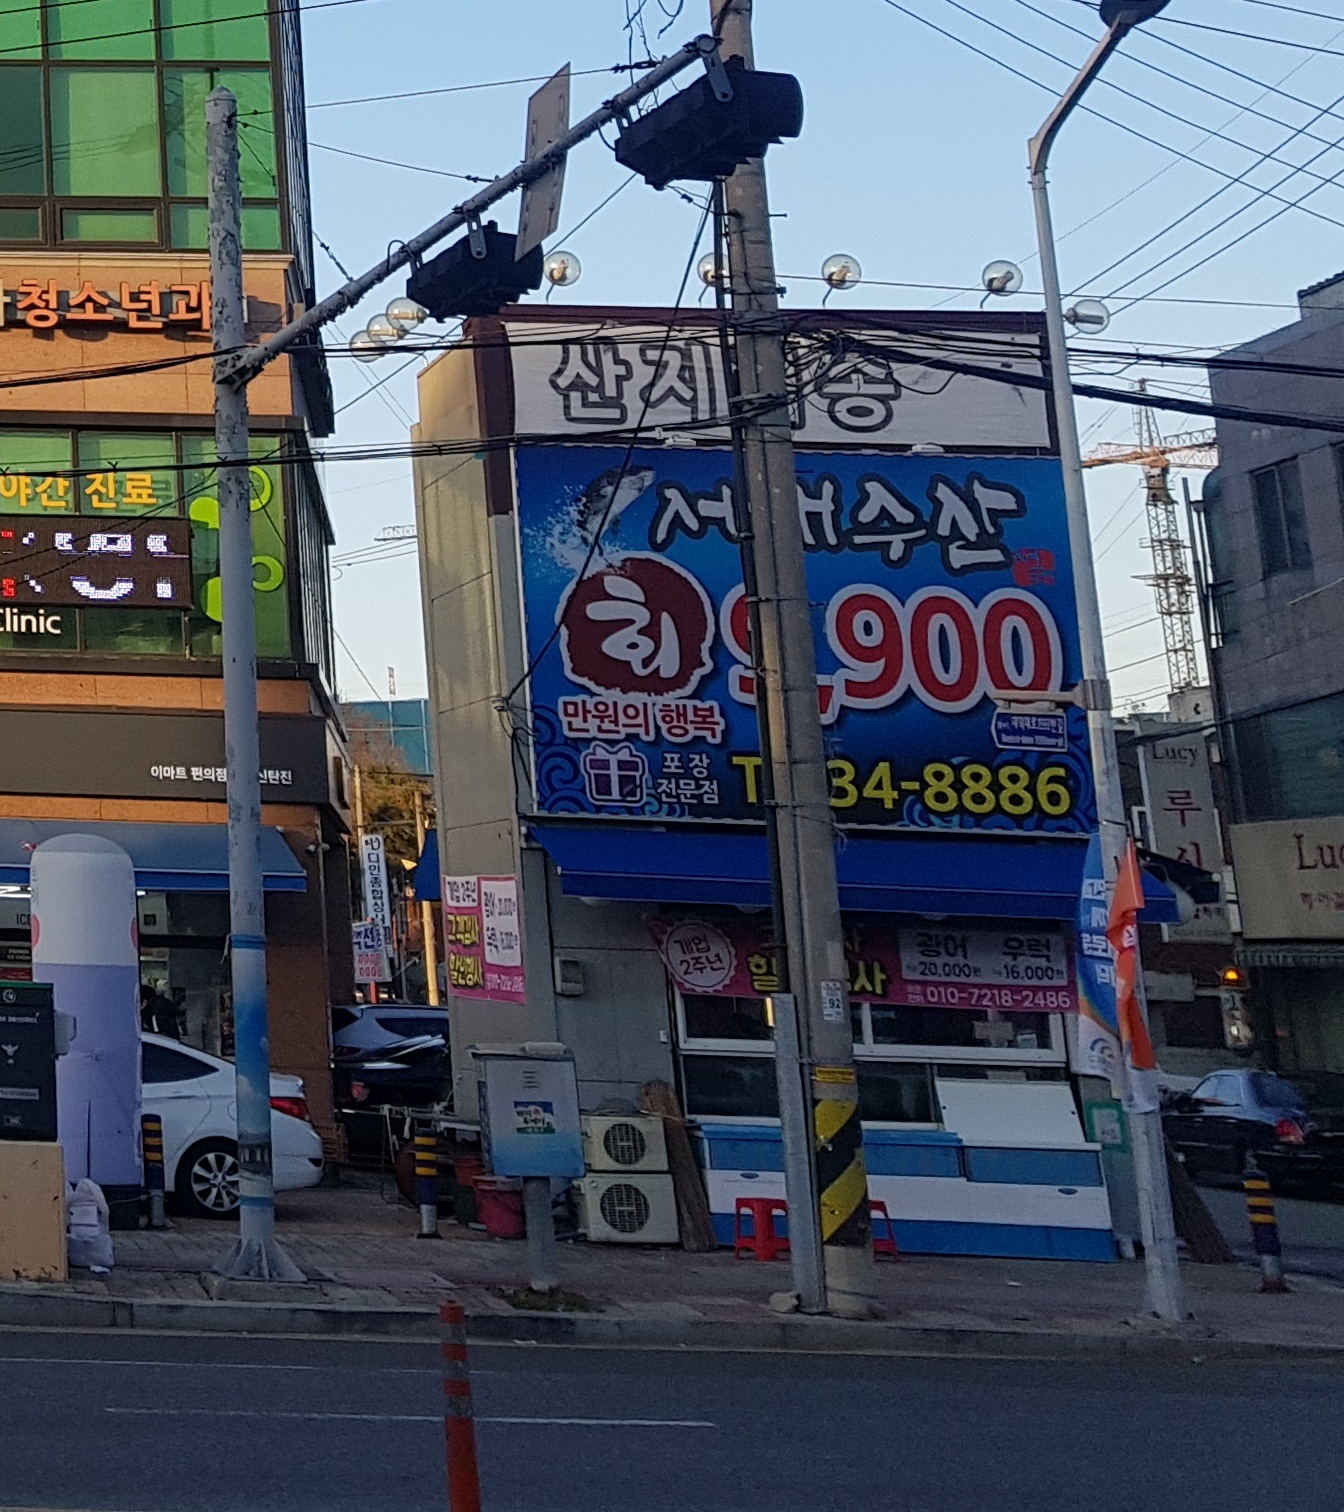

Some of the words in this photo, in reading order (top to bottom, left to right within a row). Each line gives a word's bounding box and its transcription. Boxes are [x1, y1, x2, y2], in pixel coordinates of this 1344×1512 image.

[548, 338, 903, 433] 산지송
[0, 471, 71, 509] 야간
[84, 470, 159, 509] 진료
[584, 574, 682, 678] 회
[558, 697, 652, 742] 만원의
[660, 700, 724, 745] 행복
[660, 752, 711, 777] 포장
[1153, 744, 1199, 768] Lucy
[150, 764, 188, 781] 이마트
[190, 766, 228, 783] 편의점
[657, 778, 720, 807] 전문점
[673, 932, 711, 955] 개업
[916, 931, 968, 960] 광어
[1001, 937, 1052, 964] 우럭
[679, 952, 726, 976] 2주년
[926, 986, 1072, 1009] 010-7218-2486
